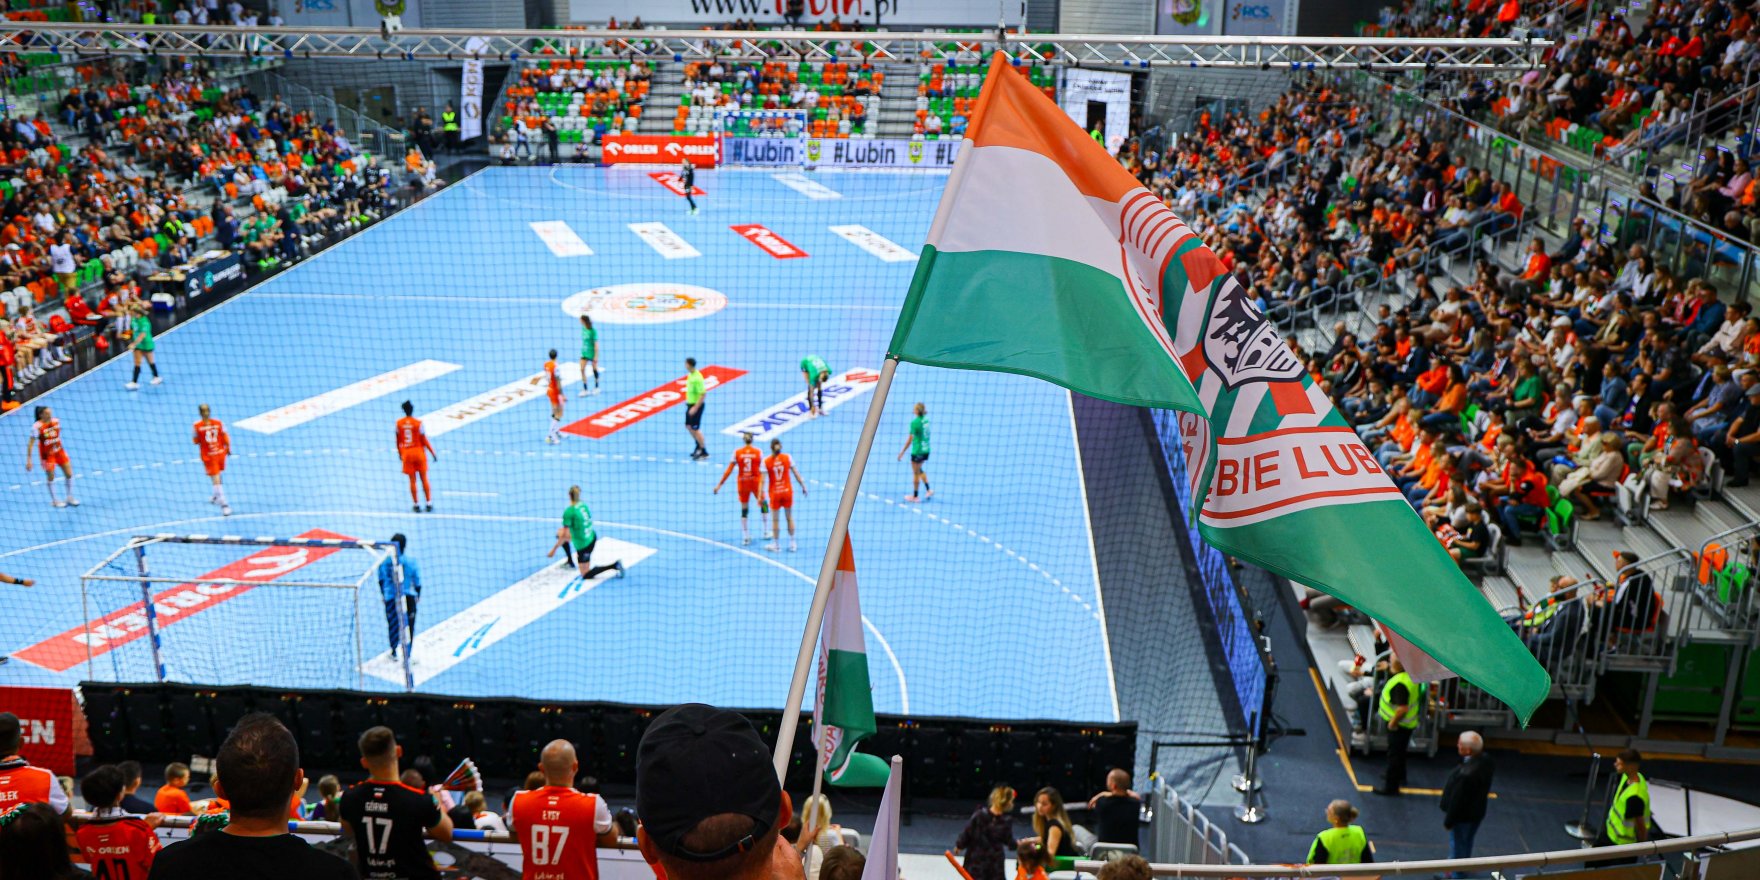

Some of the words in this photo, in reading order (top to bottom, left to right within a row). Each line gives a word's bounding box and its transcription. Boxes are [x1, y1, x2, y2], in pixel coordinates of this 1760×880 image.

[623, 145, 658, 154] ORLEN
[733, 140, 794, 162] #Lubin
[834, 142, 896, 164] #Lubin
[590, 390, 681, 428] ORLEN
[72, 578, 237, 648] ORLEN
[361, 816, 393, 854] 17
[531, 824, 570, 865] 87
